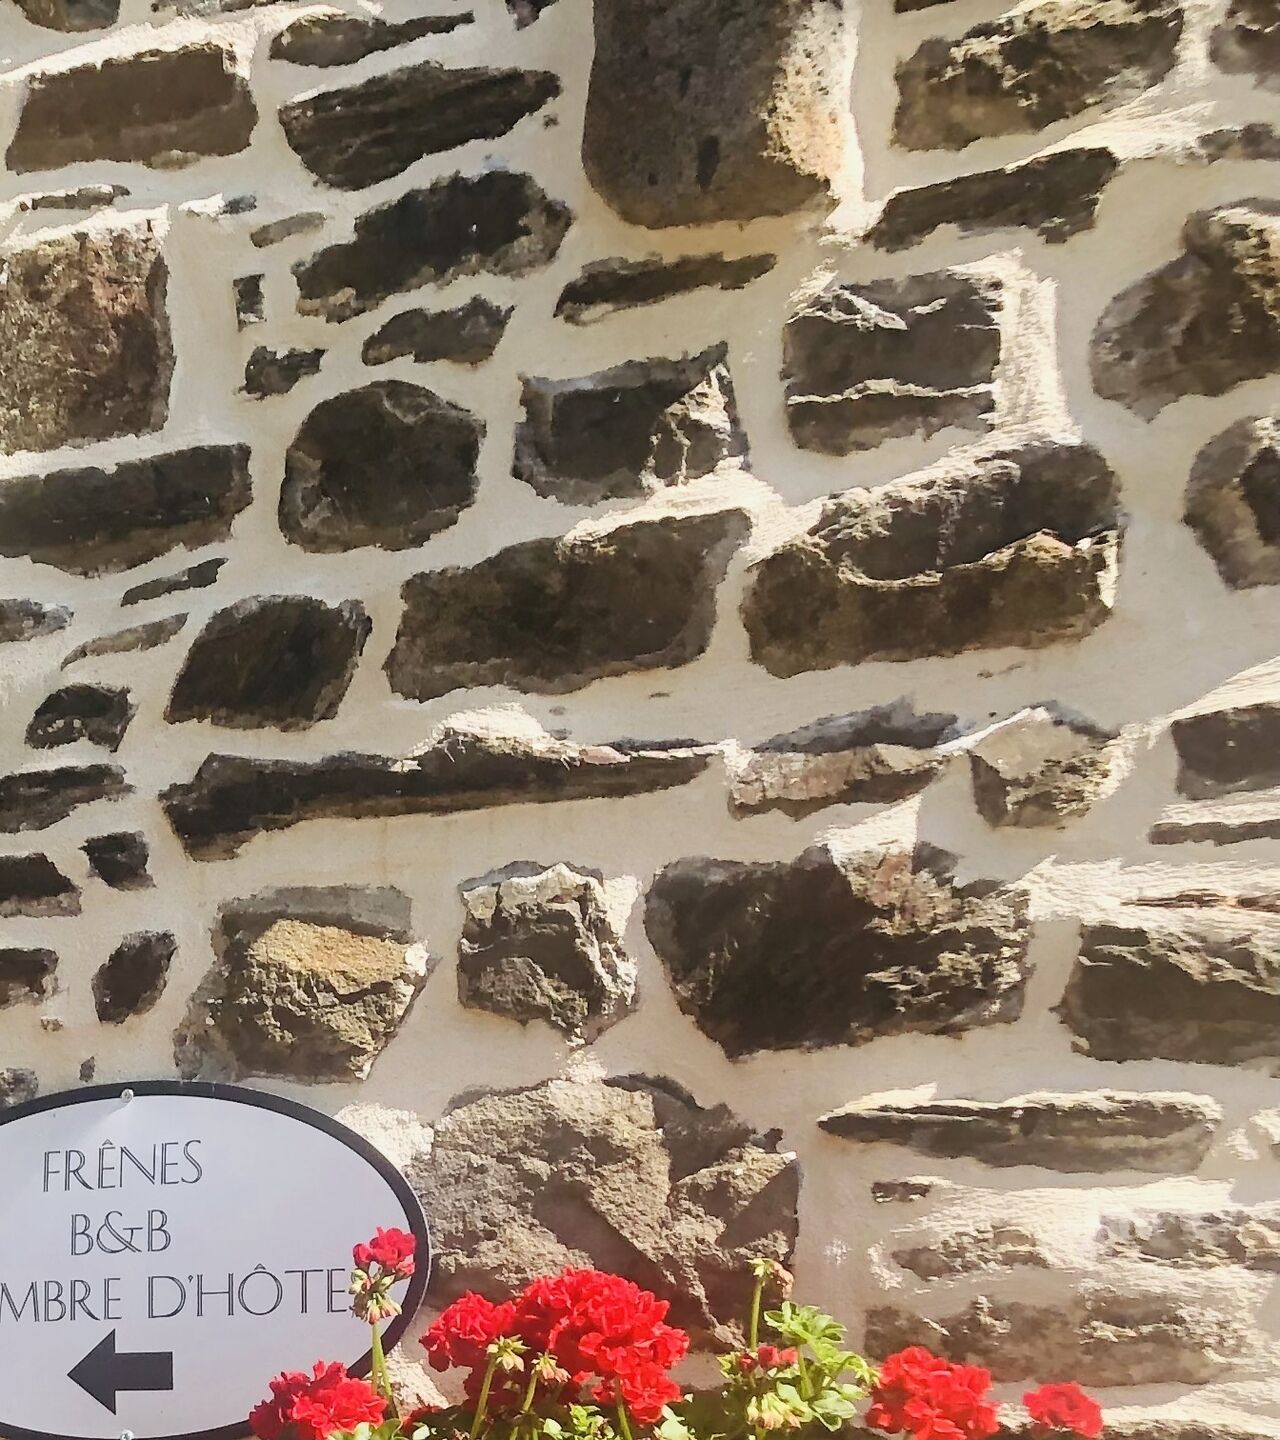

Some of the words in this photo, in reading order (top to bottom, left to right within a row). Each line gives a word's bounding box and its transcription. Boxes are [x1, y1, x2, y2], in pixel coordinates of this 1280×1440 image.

[42, 1139, 203, 1192] FRÊNES
[70, 1209, 171, 1256] B&B
[147, 1263, 358, 1319] D'HÔTE
